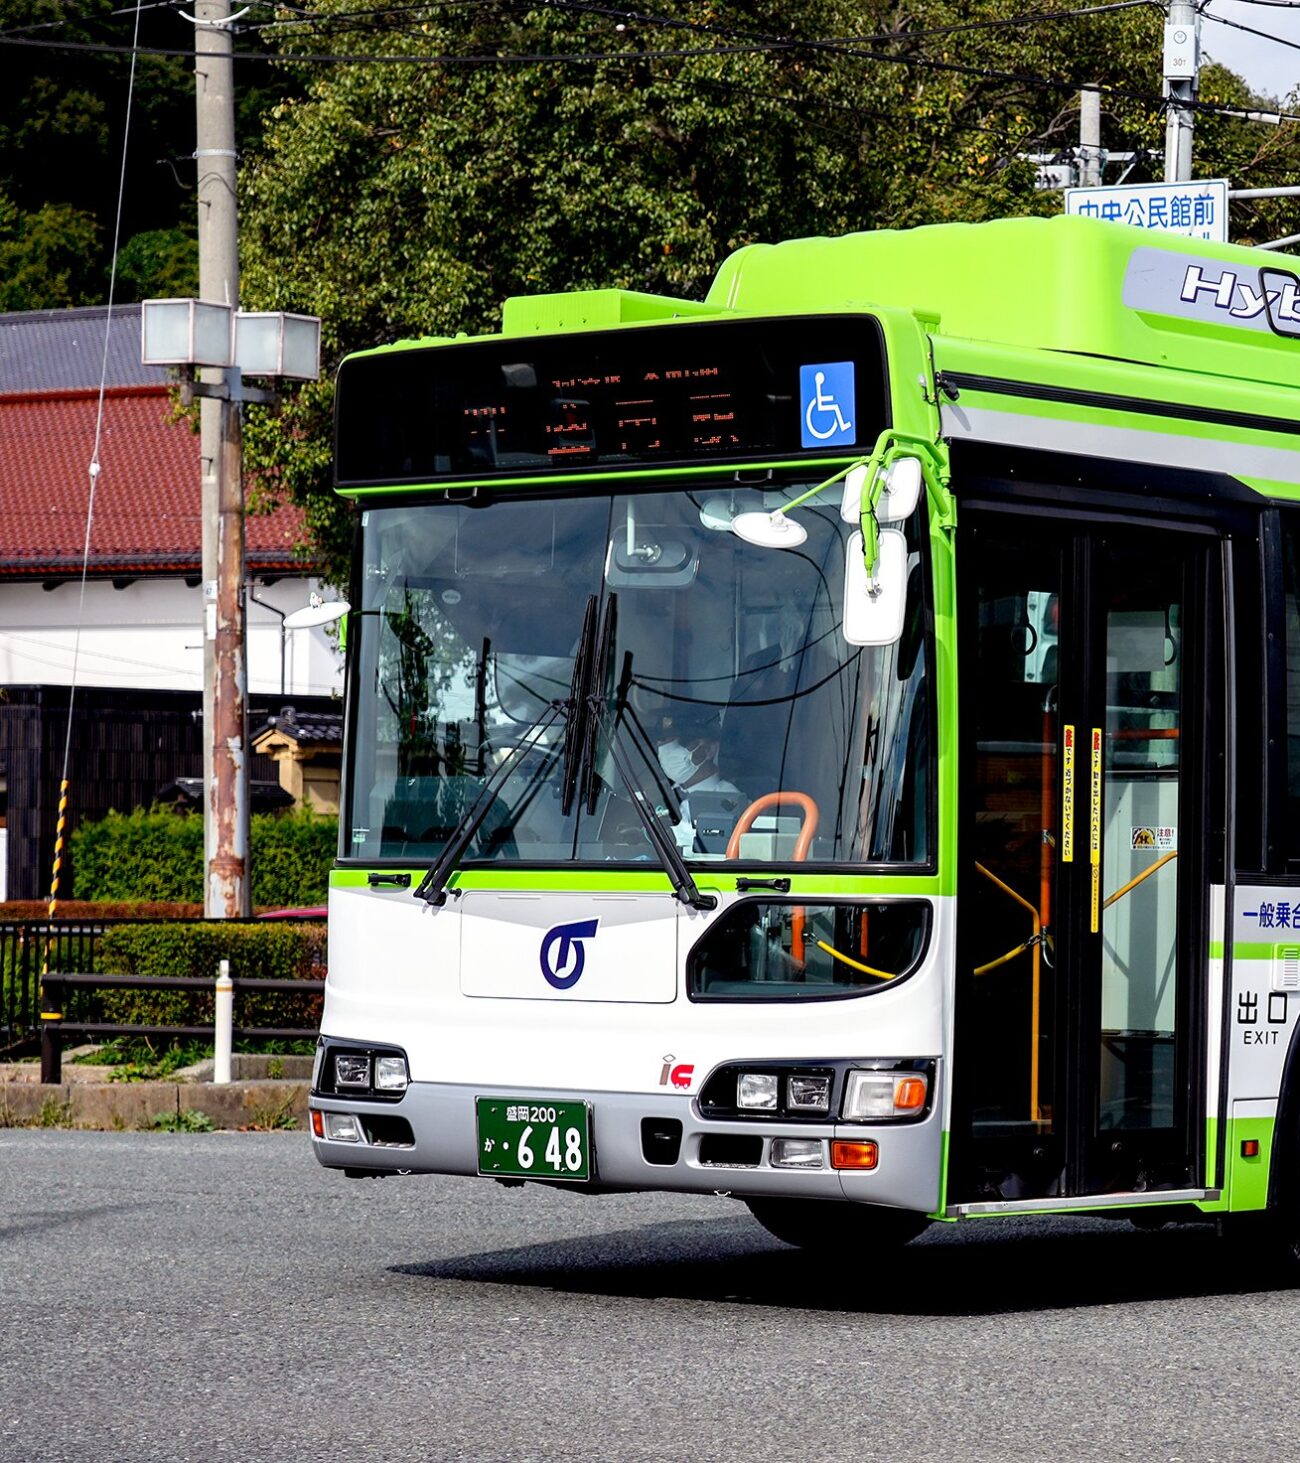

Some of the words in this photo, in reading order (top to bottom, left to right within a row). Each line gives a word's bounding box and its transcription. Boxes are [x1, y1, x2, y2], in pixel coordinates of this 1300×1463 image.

[1078, 193, 1215, 229] 中央公民館前
[1237, 991, 1288, 1025] 出口
[1243, 1031, 1280, 1045] EXIT
[484, 1138, 496, 1152] か
